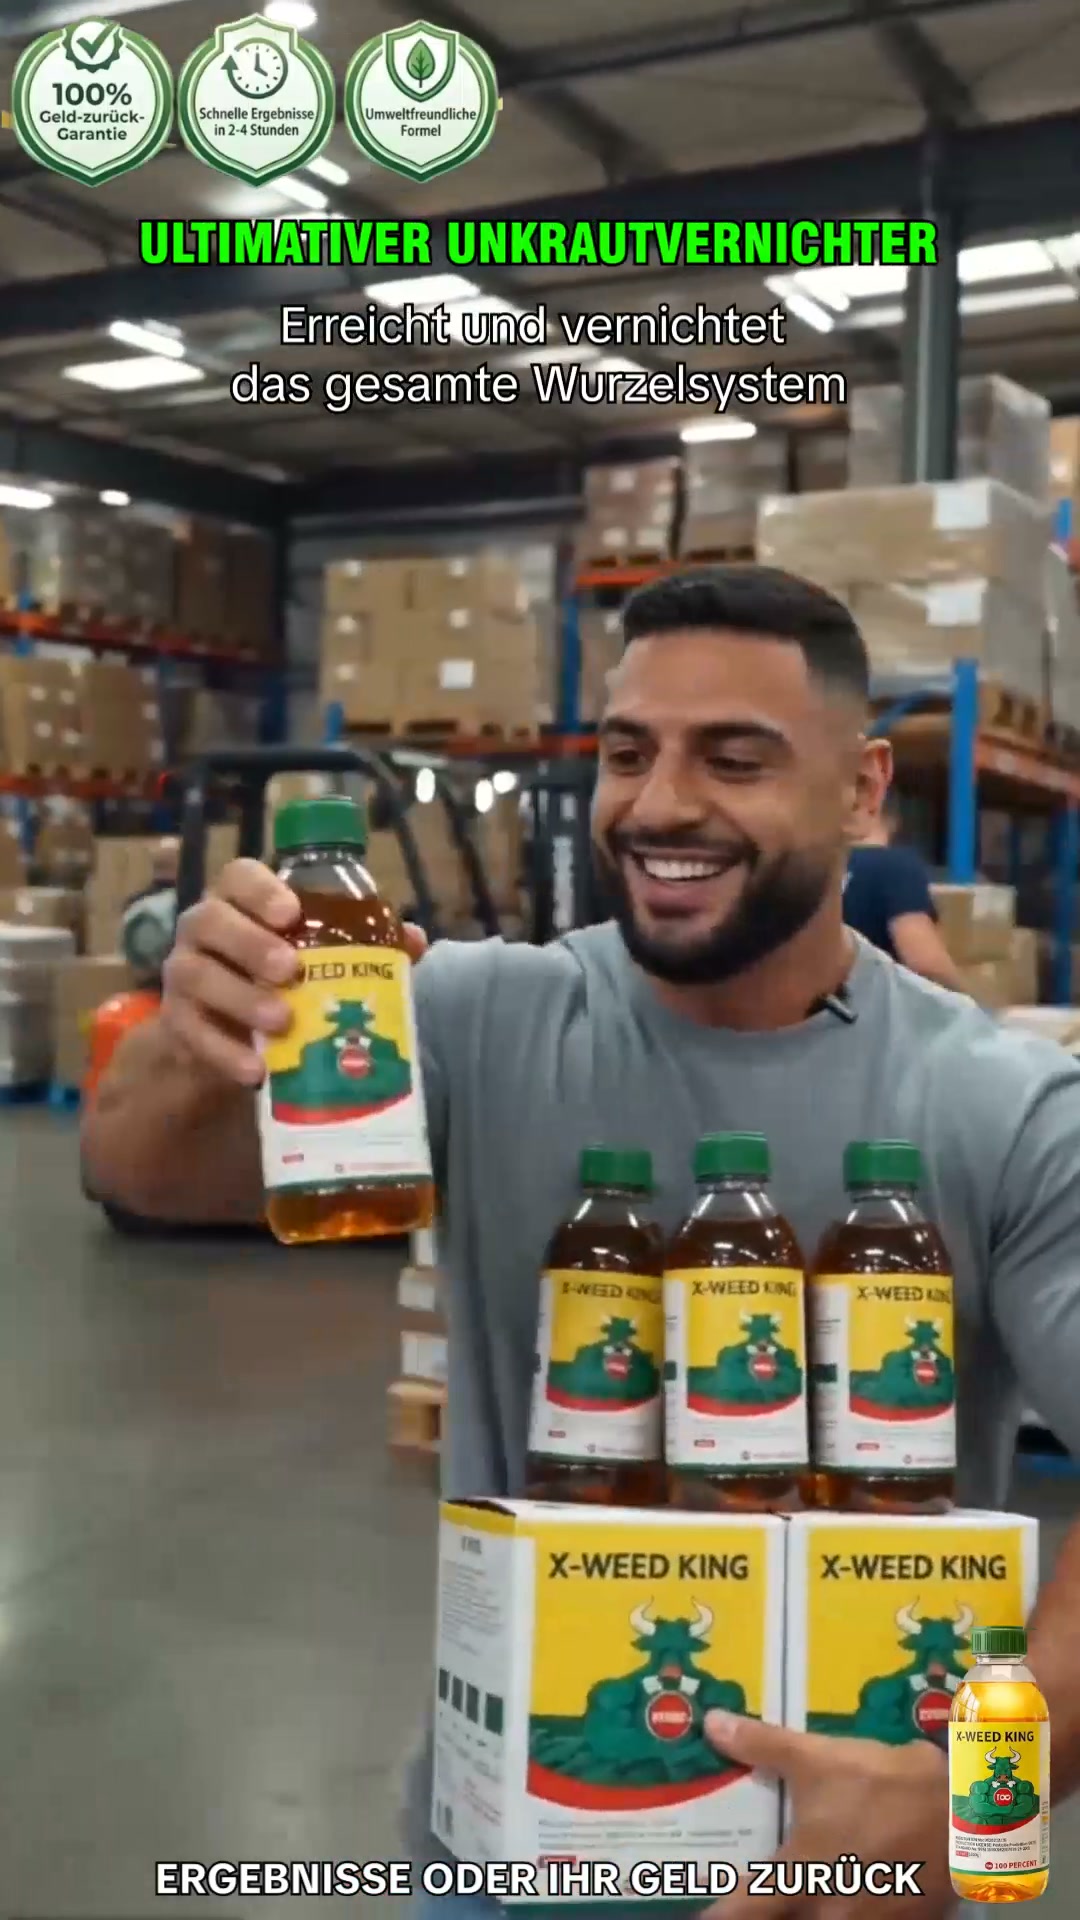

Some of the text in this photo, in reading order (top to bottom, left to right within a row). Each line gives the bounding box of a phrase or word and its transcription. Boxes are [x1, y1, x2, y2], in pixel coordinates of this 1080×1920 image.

[351, 962, 393, 980] KING
[691, 1280, 760, 1296] X-WEED
[857, 1285, 924, 1301] X-WEED
[548, 1552, 749, 1581] X-WEED KING
[820, 1554, 1007, 1580] X-WEED KING
